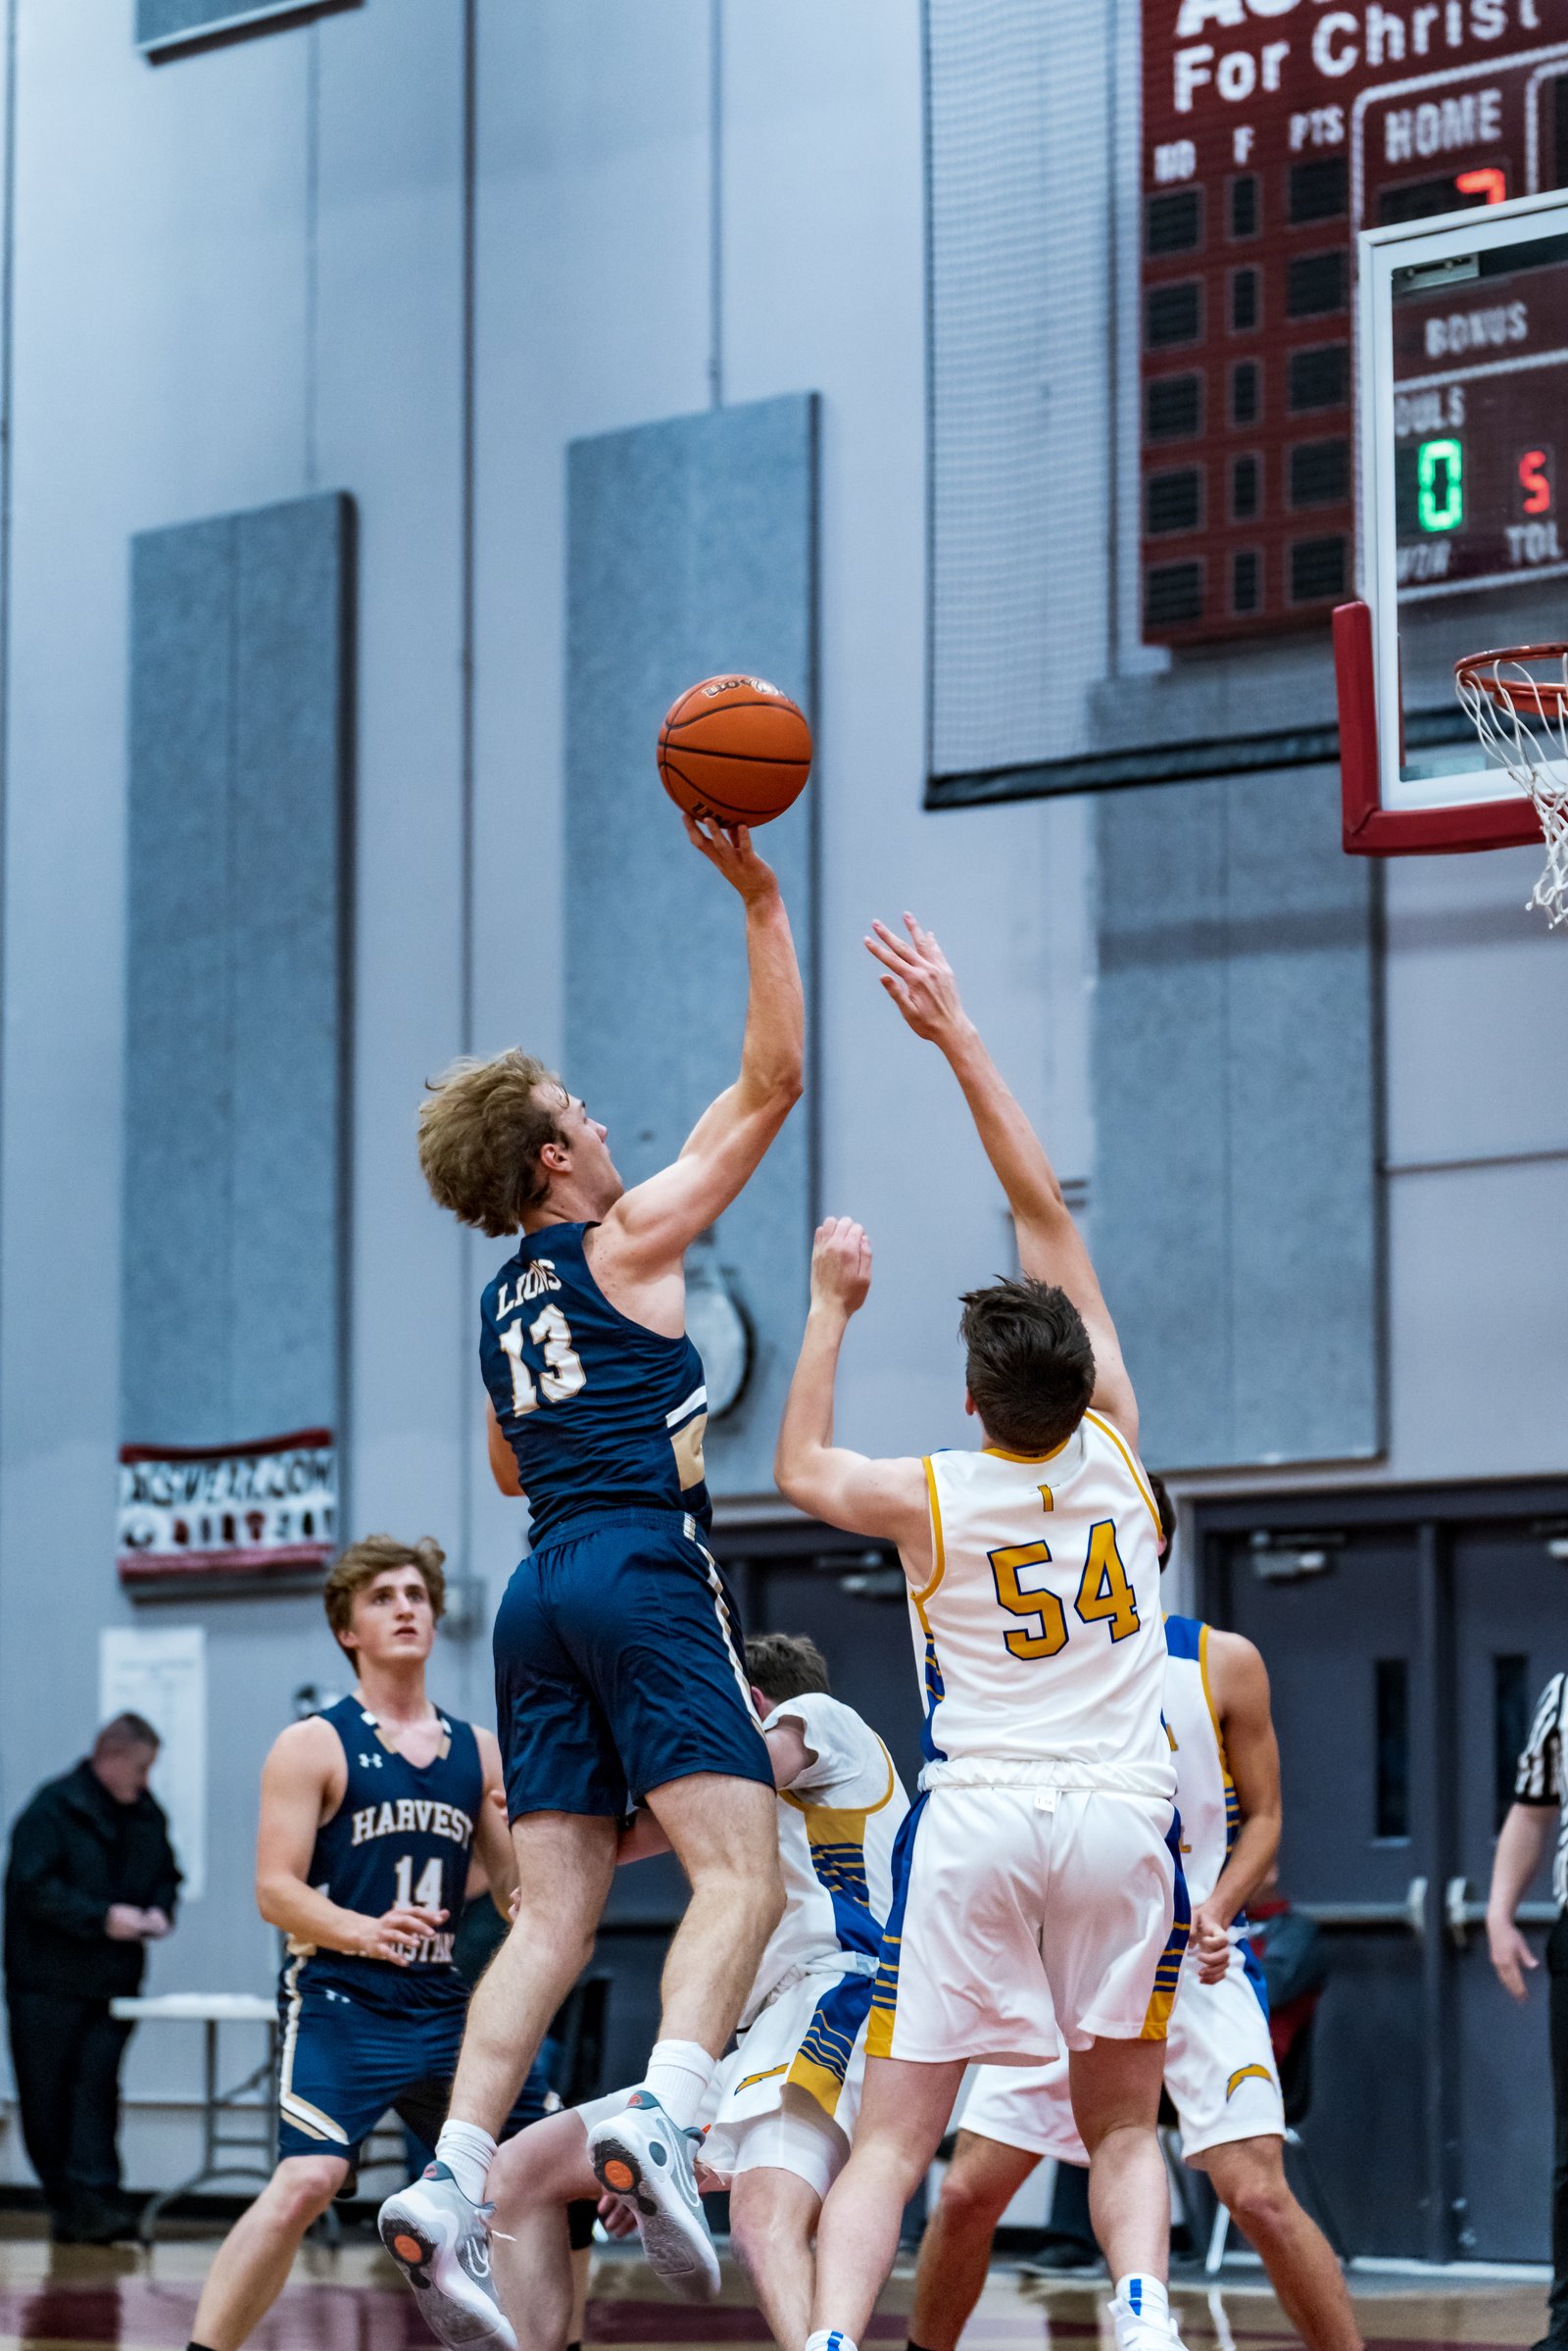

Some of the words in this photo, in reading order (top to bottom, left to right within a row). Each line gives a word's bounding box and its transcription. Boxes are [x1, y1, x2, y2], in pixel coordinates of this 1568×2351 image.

[1174, 40, 1290, 113] For
[1233, 125, 1254, 165] F
[1289, 106, 1345, 151] PTS
[1385, 88, 1502, 164] HOME
[1425, 301, 1528, 359] BONUS
[1418, 438, 1462, 532] 0
[1506, 521, 1562, 564] TOL
[499, 1303, 587, 1418] 13
[987, 1517, 1141, 1661] 54
[351, 1798, 474, 1849] HARVEST
[394, 1855, 443, 1913] 14
